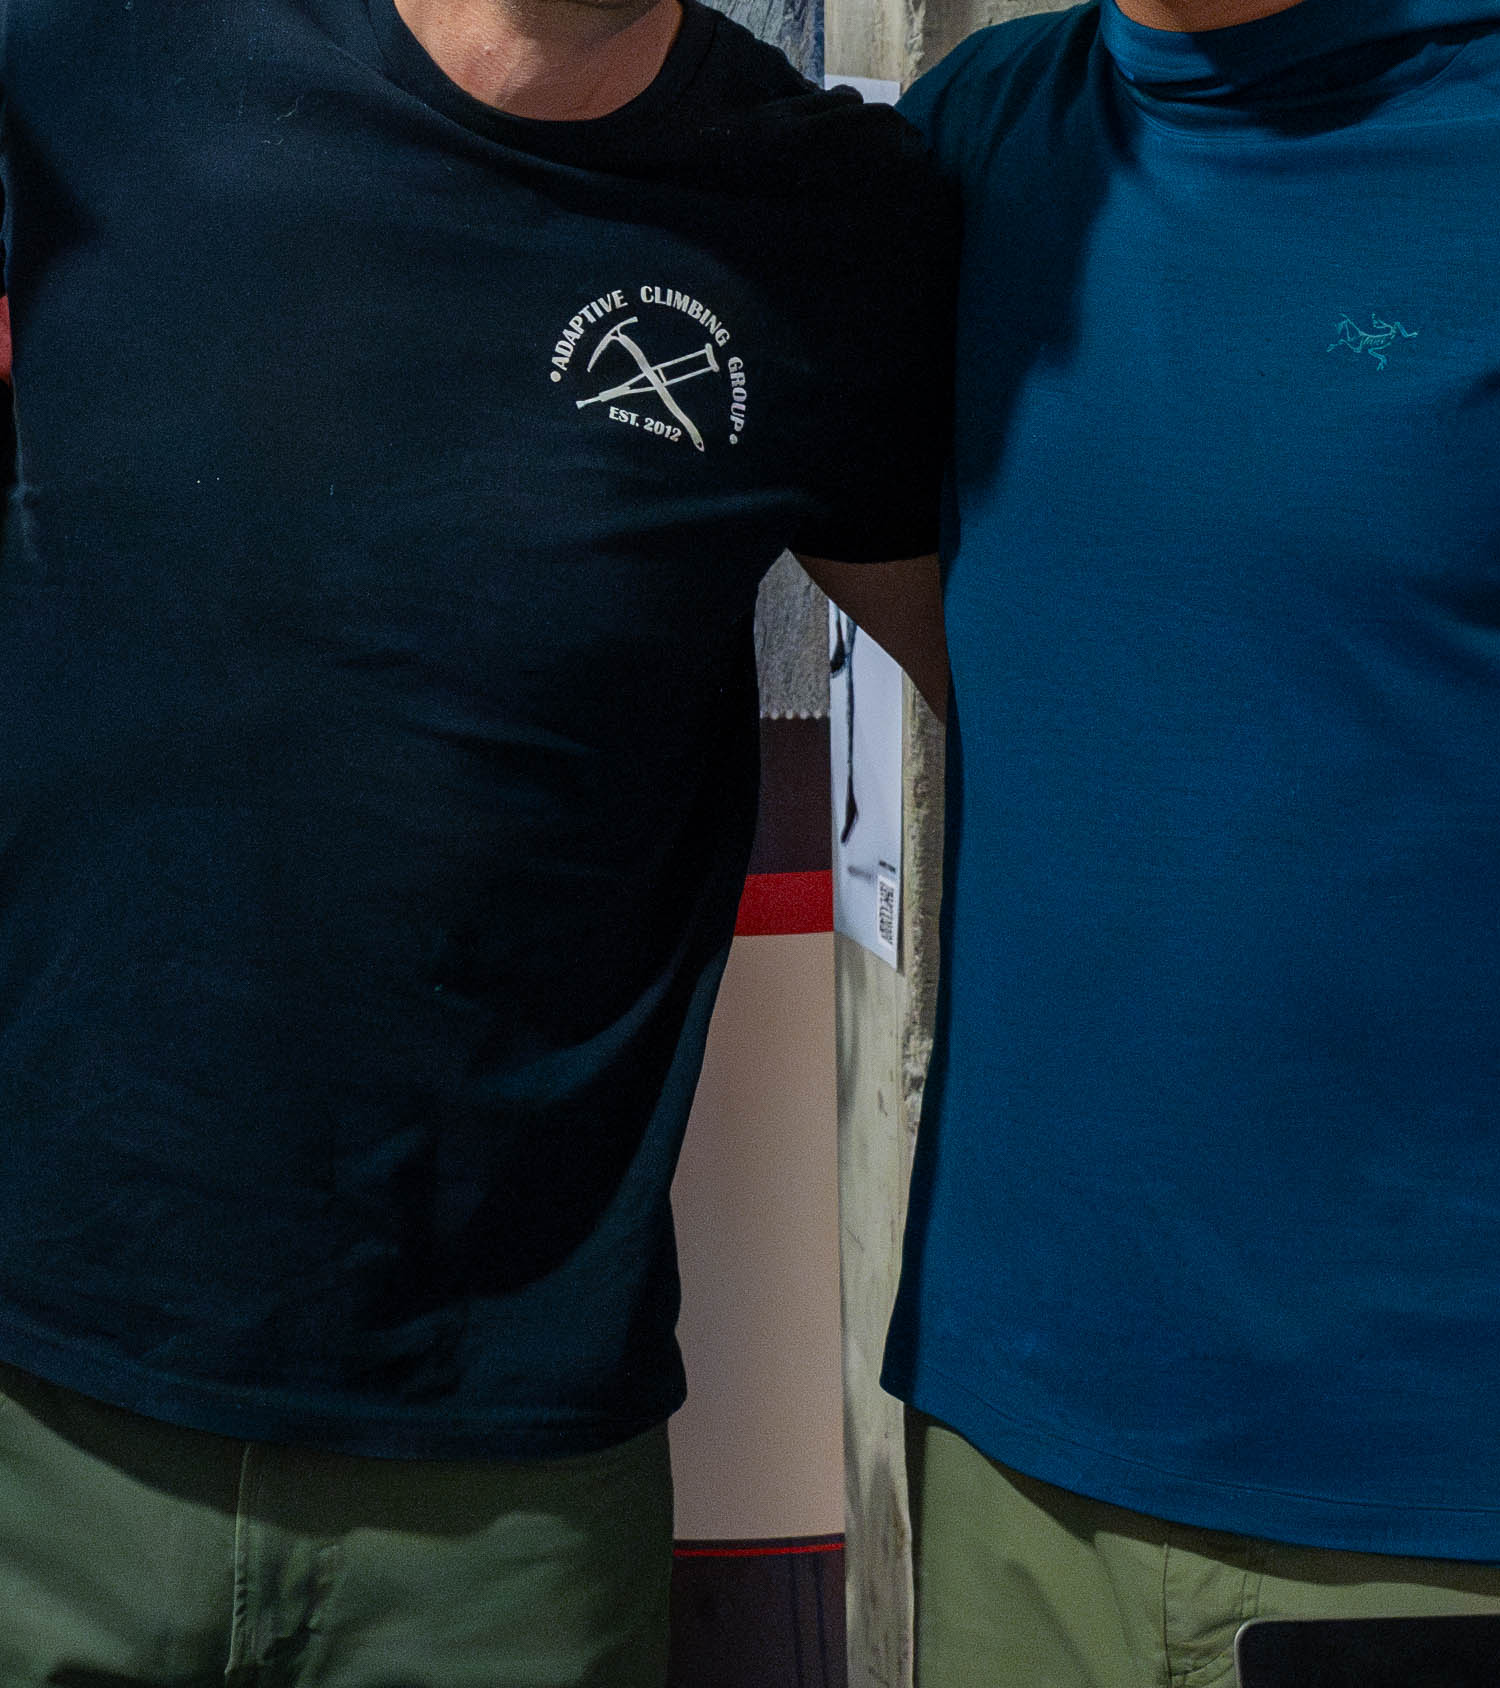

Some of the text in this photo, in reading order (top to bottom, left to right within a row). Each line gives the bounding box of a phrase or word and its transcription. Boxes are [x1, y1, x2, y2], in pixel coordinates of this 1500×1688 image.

[551, 288, 628, 372] ADAPTIVE
[640, 285, 731, 348] CLIMBING
[609, 406, 683, 443] EST. 2012
[727, 355, 748, 433] GROUP
